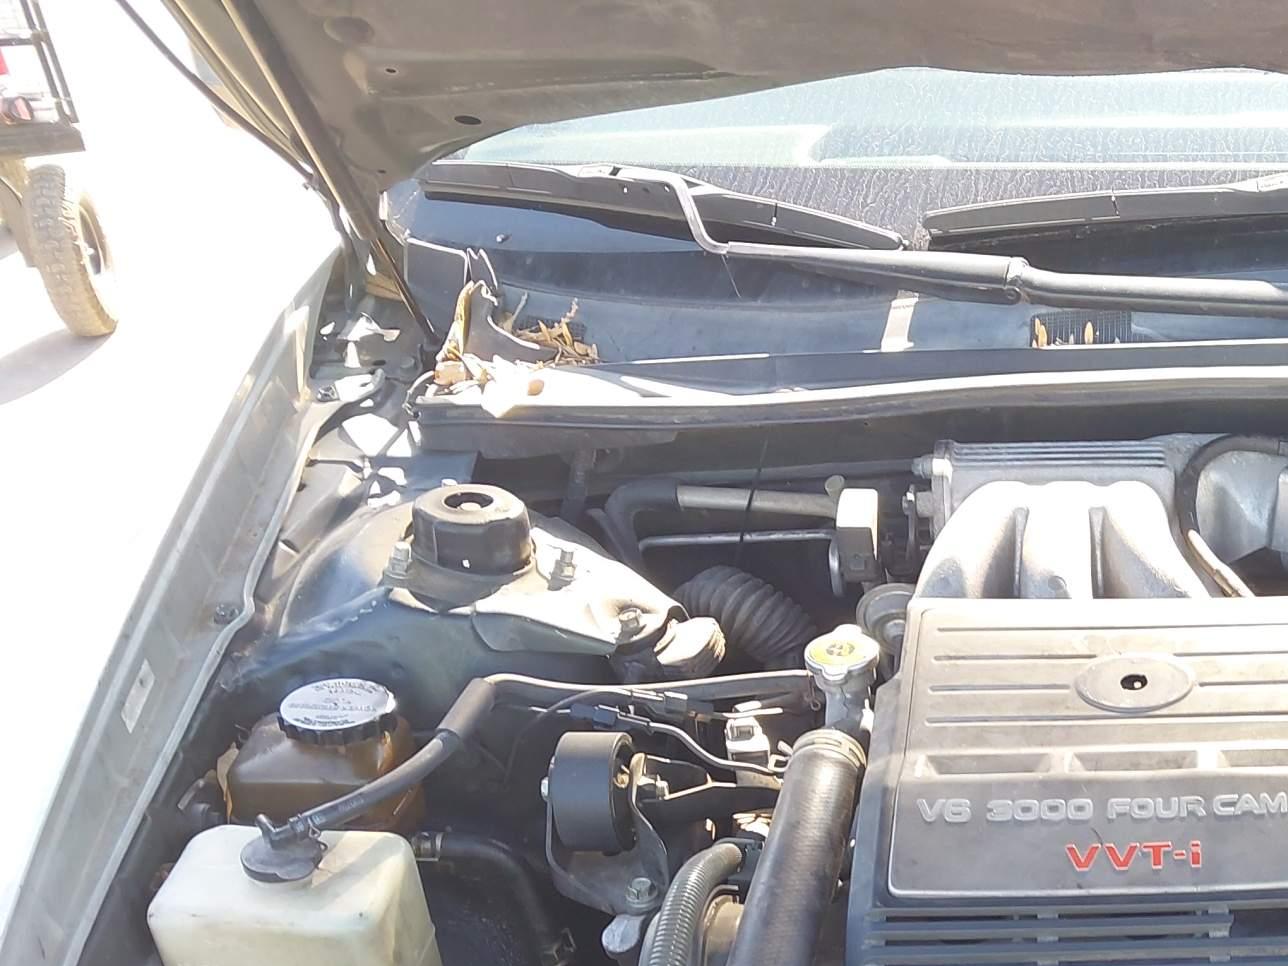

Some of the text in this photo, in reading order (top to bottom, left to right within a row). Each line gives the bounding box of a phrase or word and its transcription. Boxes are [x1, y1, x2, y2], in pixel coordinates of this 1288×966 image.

[916, 797, 972, 823] V6
[986, 797, 1094, 823] 3000
[1107, 795, 1207, 820] FOUR
[1213, 791, 1288, 818] CAM
[1065, 840, 1203, 873] VVT-i
